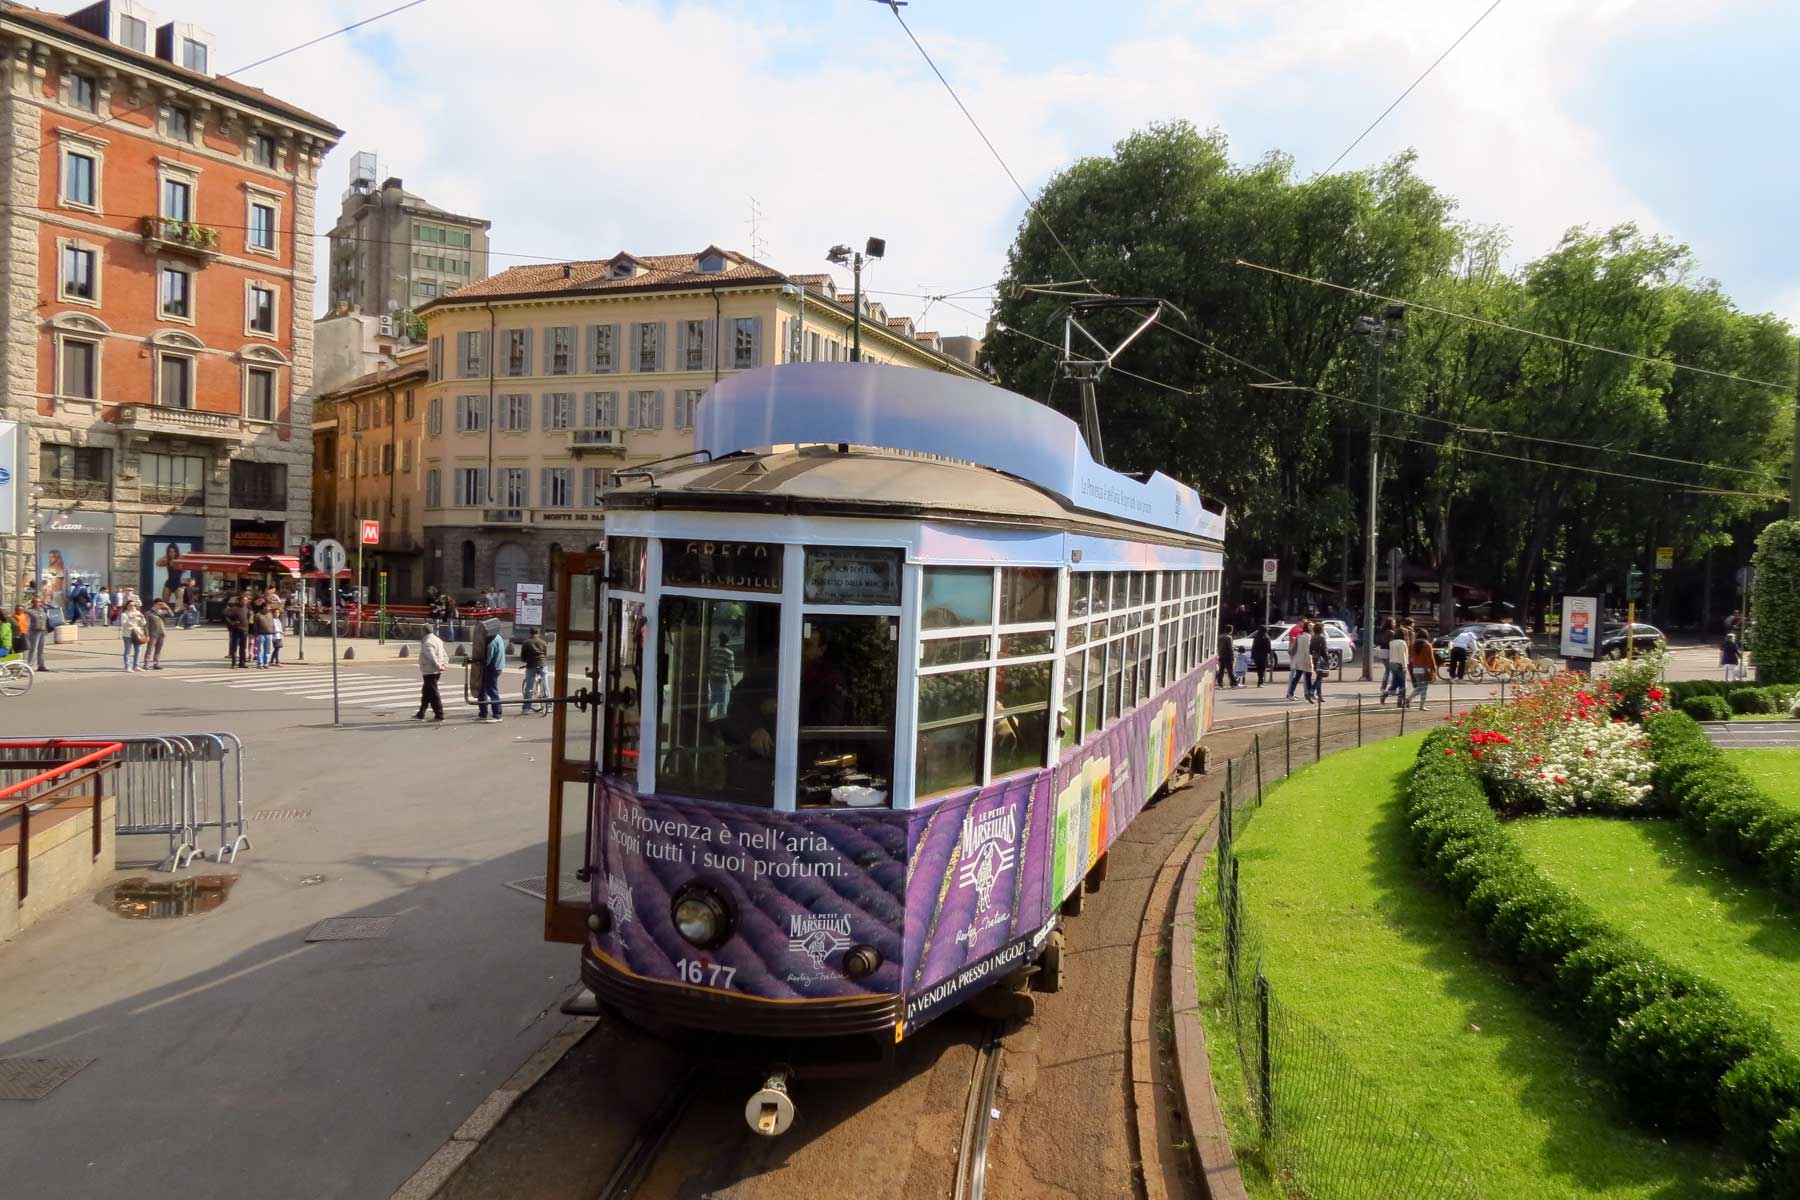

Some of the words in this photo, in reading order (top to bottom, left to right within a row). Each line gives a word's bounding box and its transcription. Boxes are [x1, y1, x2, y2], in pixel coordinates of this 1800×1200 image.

[365, 526, 377, 539] M
[543, 513, 572, 521] MONTE
[618, 804, 628, 822] La
[631, 807, 712, 842] Provenza
[719, 823, 731, 844] è
[978, 813, 987, 823] LE
[988, 806, 1006, 820] PETIT
[961, 803, 1017, 861] MARSEILLAIS
[611, 821, 640, 854] Scopri
[646, 840, 683, 863] tutti
[691, 845, 696, 865] i
[704, 852, 746, 872] suoi
[754, 856, 848, 880] profumi.
[790, 913, 852, 937] MARSEILLAIS
[677, 958, 737, 989] 1677
[917, 980, 957, 1012] VENDITA
[958, 961, 989, 988] PRESSO
[990, 960, 994, 971] I
[994, 941, 1026, 968] NEGOZI
